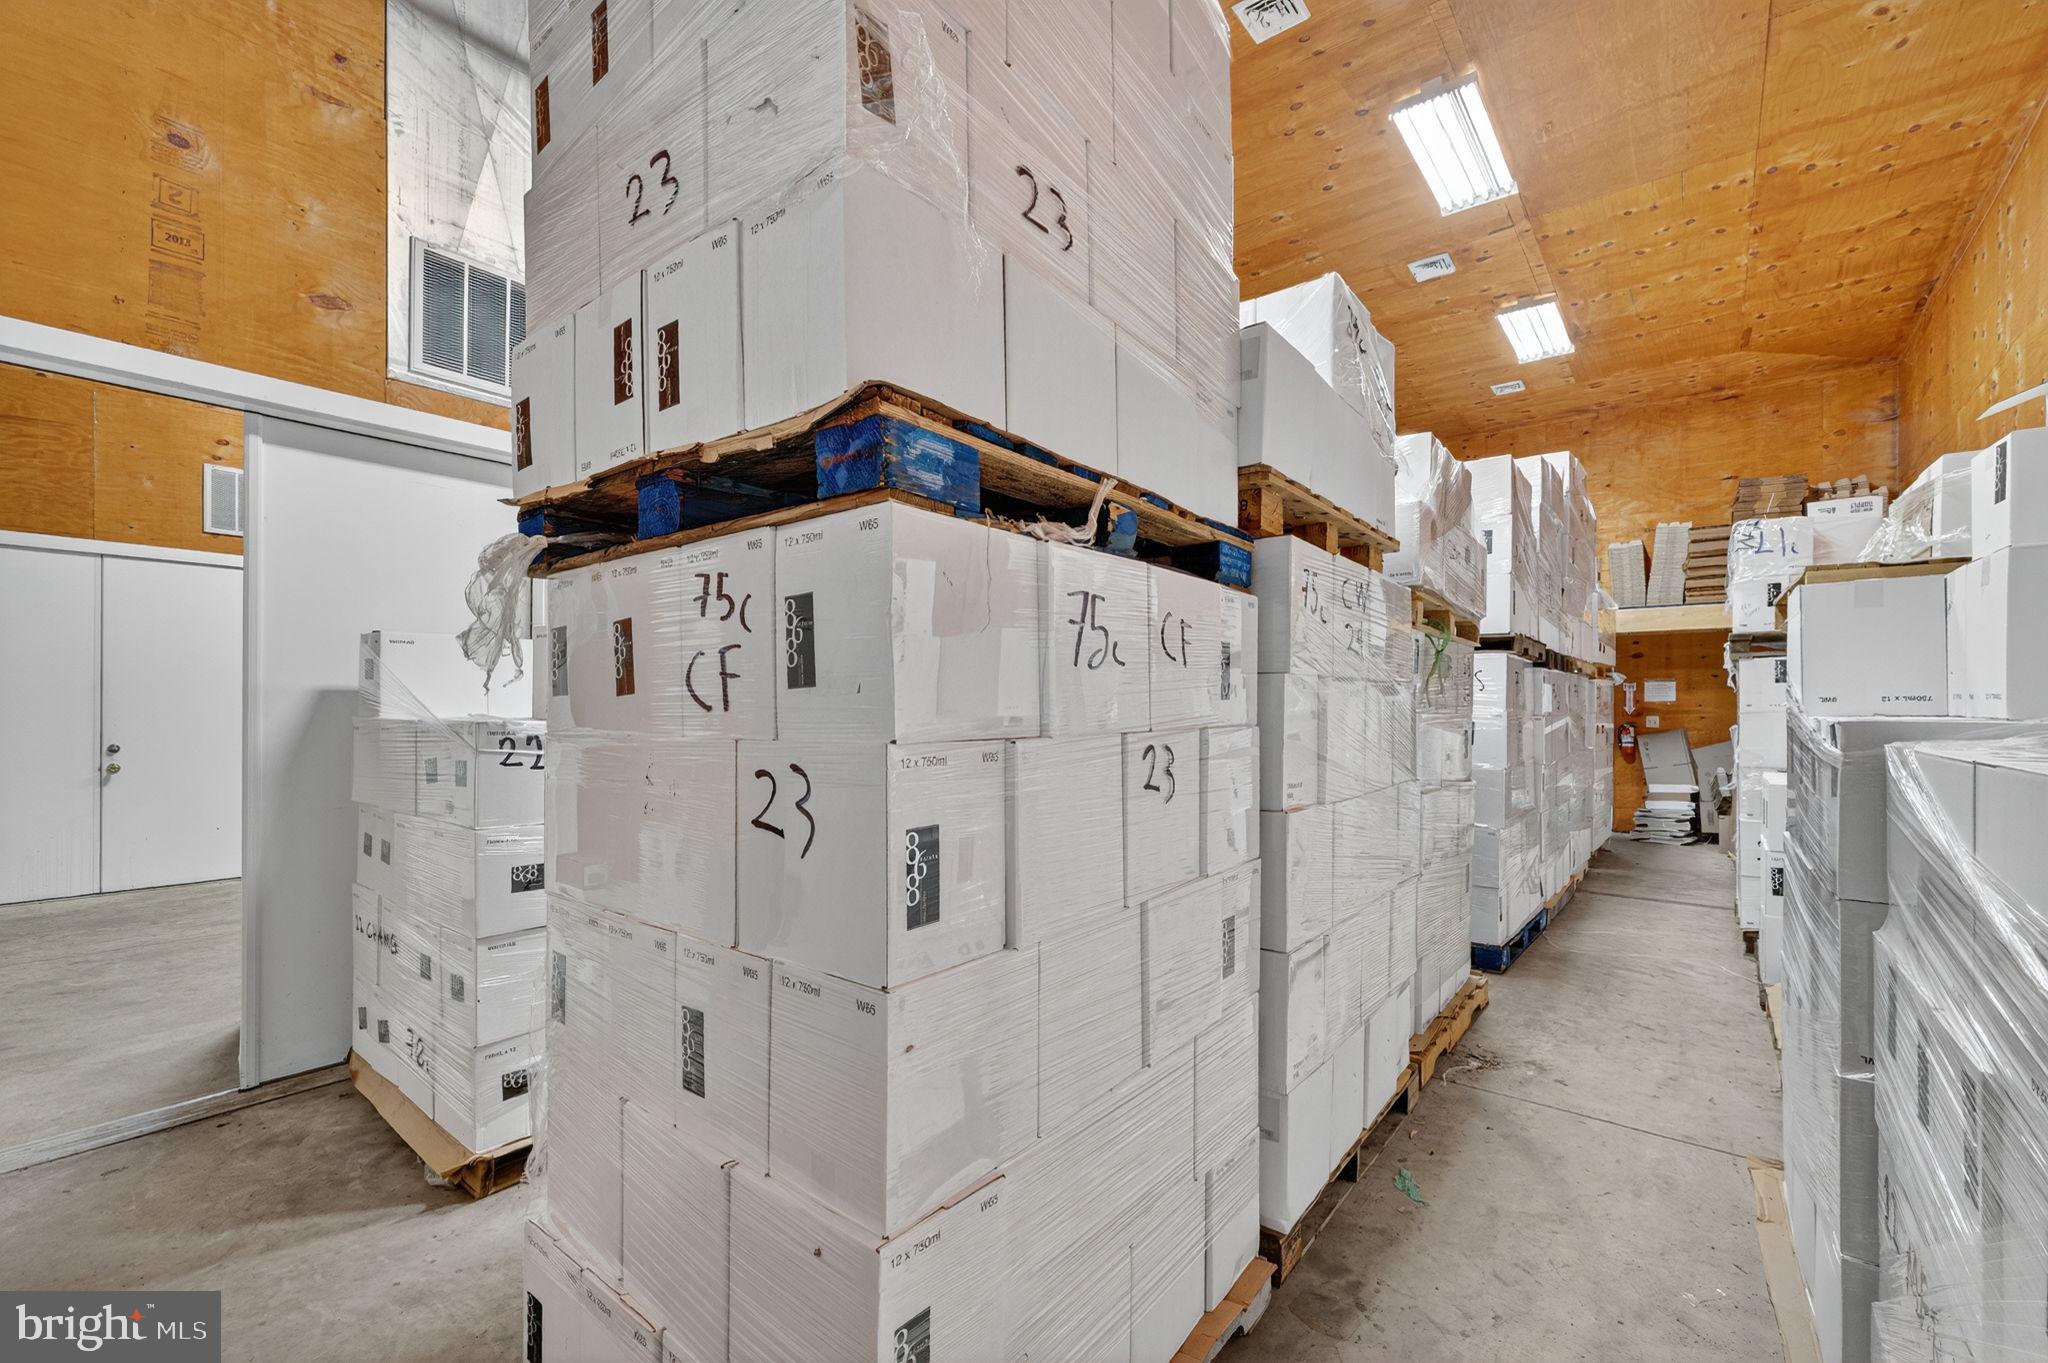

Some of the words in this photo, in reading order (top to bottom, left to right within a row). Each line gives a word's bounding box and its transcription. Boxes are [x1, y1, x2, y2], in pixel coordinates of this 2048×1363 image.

[626, 149, 679, 227] 23
[1015, 164, 1073, 252] 23
[858, 518, 880, 532] W65
[685, 643, 742, 713] CF
[499, 735, 545, 769] 22
[900, 757, 912, 769] 12
[921, 755, 949, 768] 750ml
[1142, 743, 1176, 805] 23
[750, 762, 816, 860] 23
[856, 998, 877, 1016] W65
[891, 1254, 902, 1269] 12
[913, 1229, 942, 1256] 750ml
